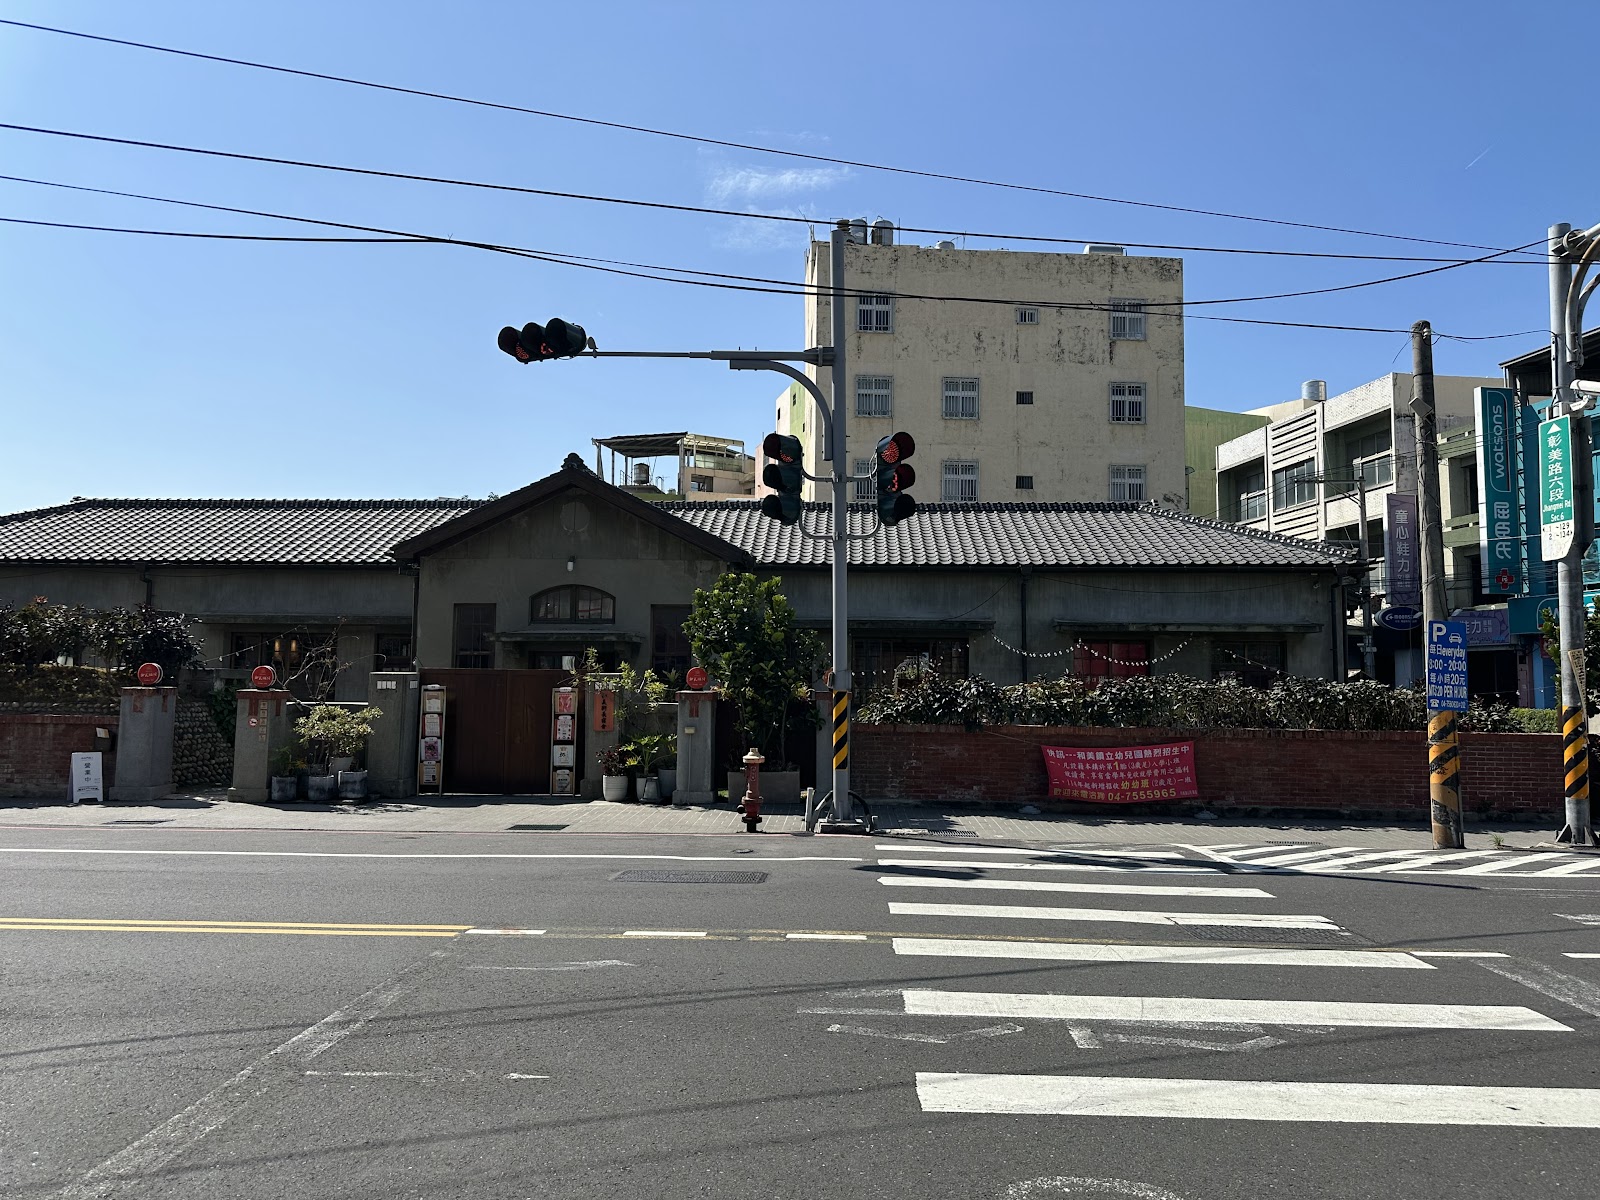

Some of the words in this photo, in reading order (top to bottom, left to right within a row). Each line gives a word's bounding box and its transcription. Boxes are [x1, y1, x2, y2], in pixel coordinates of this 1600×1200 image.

[1493, 404, 1505, 479] watsons
[1547, 434, 1565, 502] 彰美路六段
[1394, 508, 1411, 573] 童心鞋力
[1432, 623, 1447, 642] P
[1429, 659, 1444, 671] 8:00
[1448, 660, 1467, 672] 20:00
[1429, 672, 1466, 685] 每小時20元
[1443, 685, 1454, 698] PER
[1454, 686, 1468, 699] HOUR
[1107, 788, 1177, 801] 04-7555965
